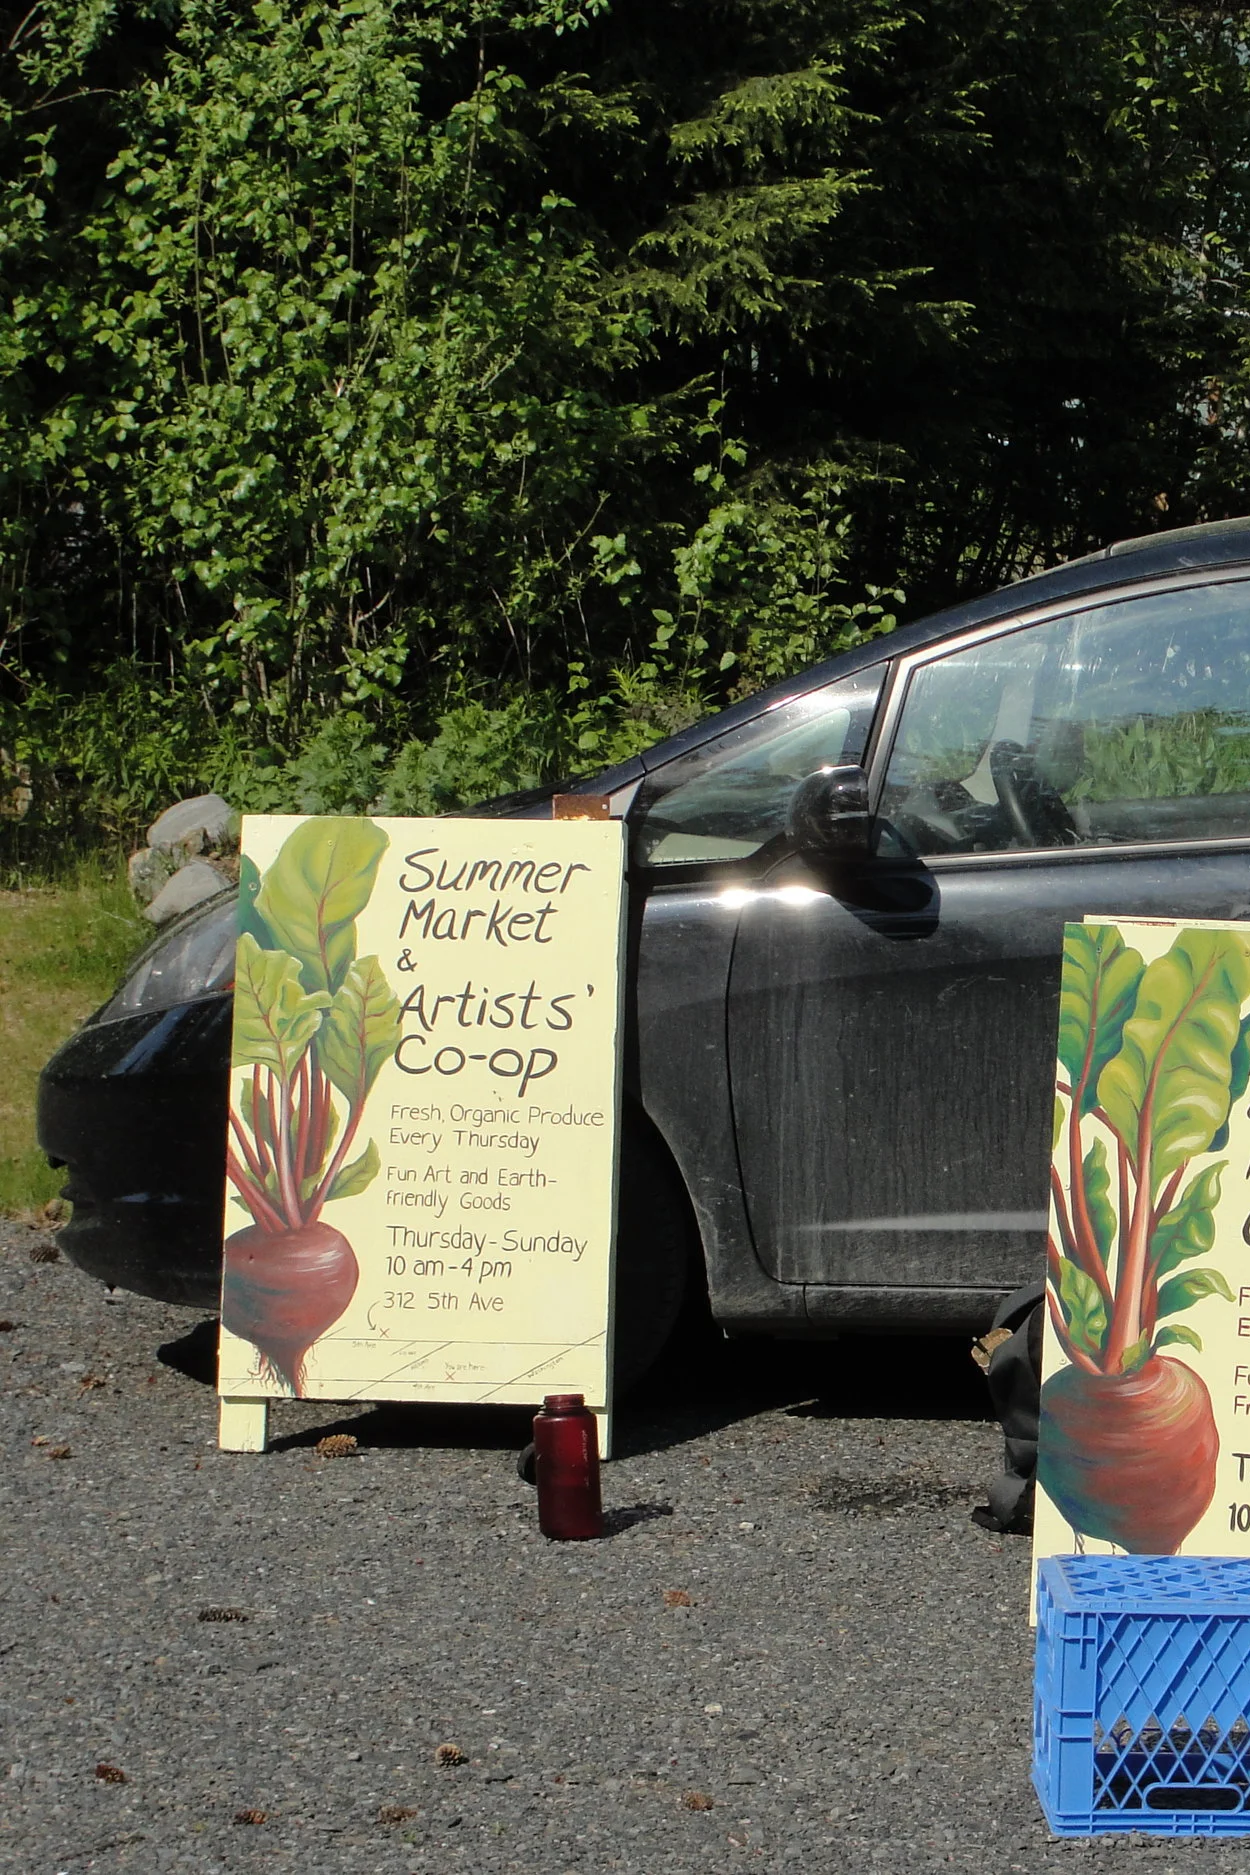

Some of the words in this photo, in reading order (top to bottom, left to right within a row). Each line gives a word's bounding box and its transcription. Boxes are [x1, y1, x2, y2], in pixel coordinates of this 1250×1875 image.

[399, 848, 591, 894] Summer
[399, 899, 558, 946] Market
[397, 949, 418, 972] &
[396, 980, 594, 1033] Artists'
[393, 1034, 558, 1098] Co-op
[391, 1104, 444, 1123] Fresh,
[450, 1104, 520, 1127] Organic
[529, 1104, 604, 1126] Produce
[390, 1128, 442, 1153] Every
[453, 1130, 539, 1158] Thursday
[388, 1167, 416, 1181] Fun
[423, 1165, 451, 1183] Art
[460, 1168, 488, 1184] and
[498, 1168, 557, 1187] Earth-
[460, 1192, 510, 1211] Goods
[386, 1256, 406, 1275] 10
[479, 1261, 512, 1284] pm
[384, 1291, 415, 1309] 312
[428, 1292, 458, 1310] 5th
[469, 1292, 503, 1311] Ave
